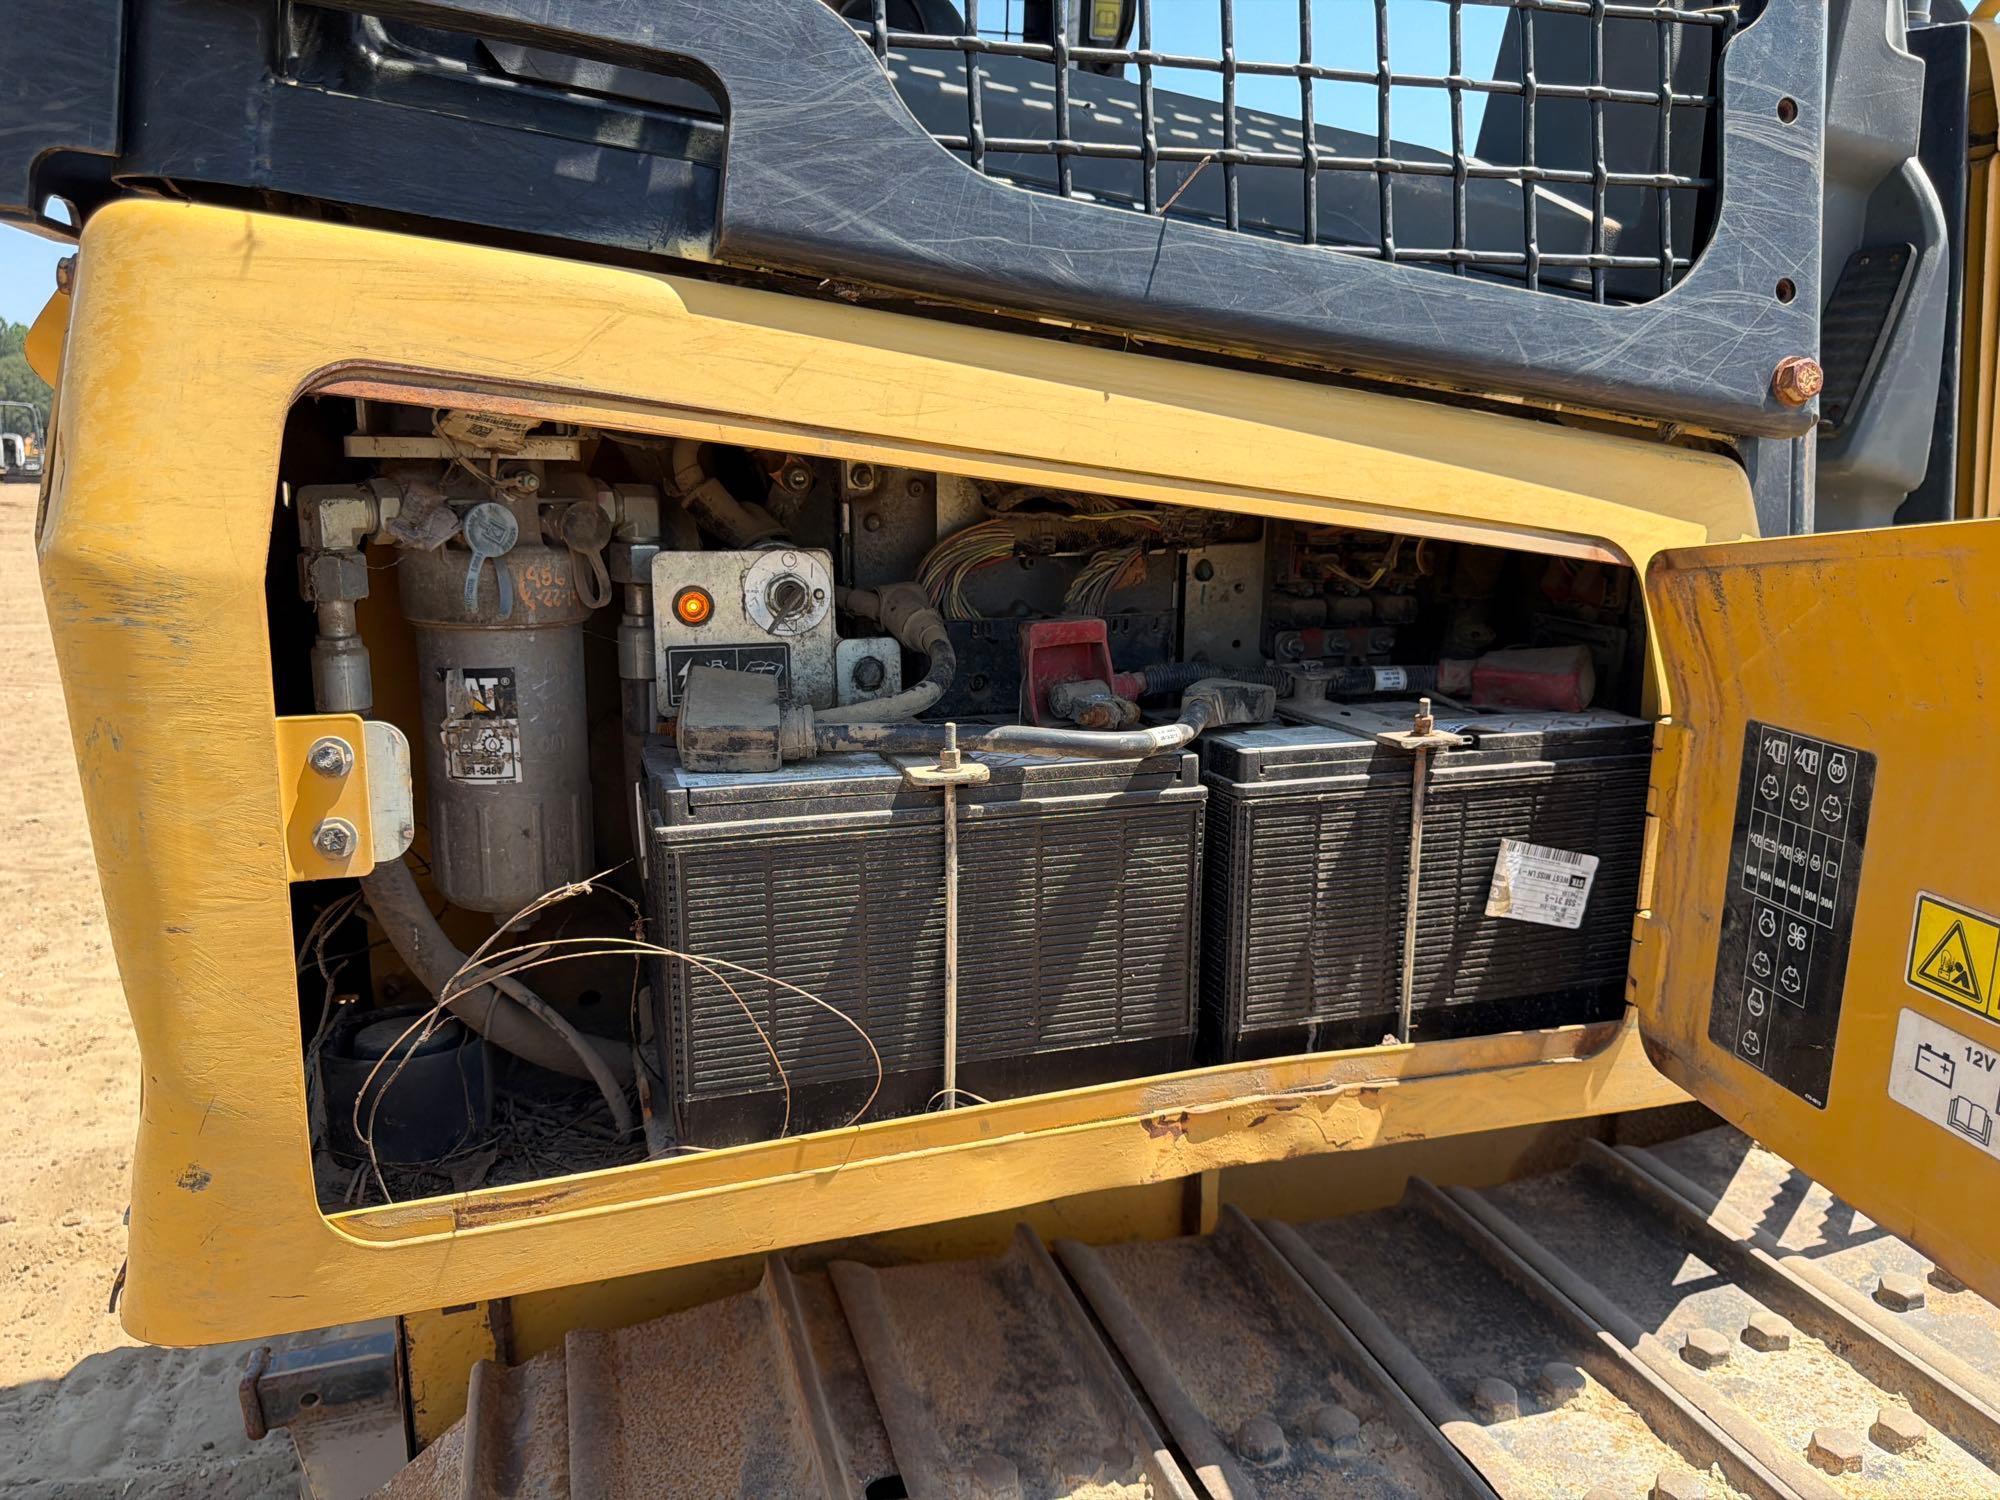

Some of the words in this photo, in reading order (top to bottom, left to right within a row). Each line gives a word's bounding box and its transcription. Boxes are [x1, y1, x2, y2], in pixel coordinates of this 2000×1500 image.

[1804, 890, 1817, 902] 50A
[1820, 897, 1833, 909] 30A
[1965, 1046, 1996, 1072] 12V
